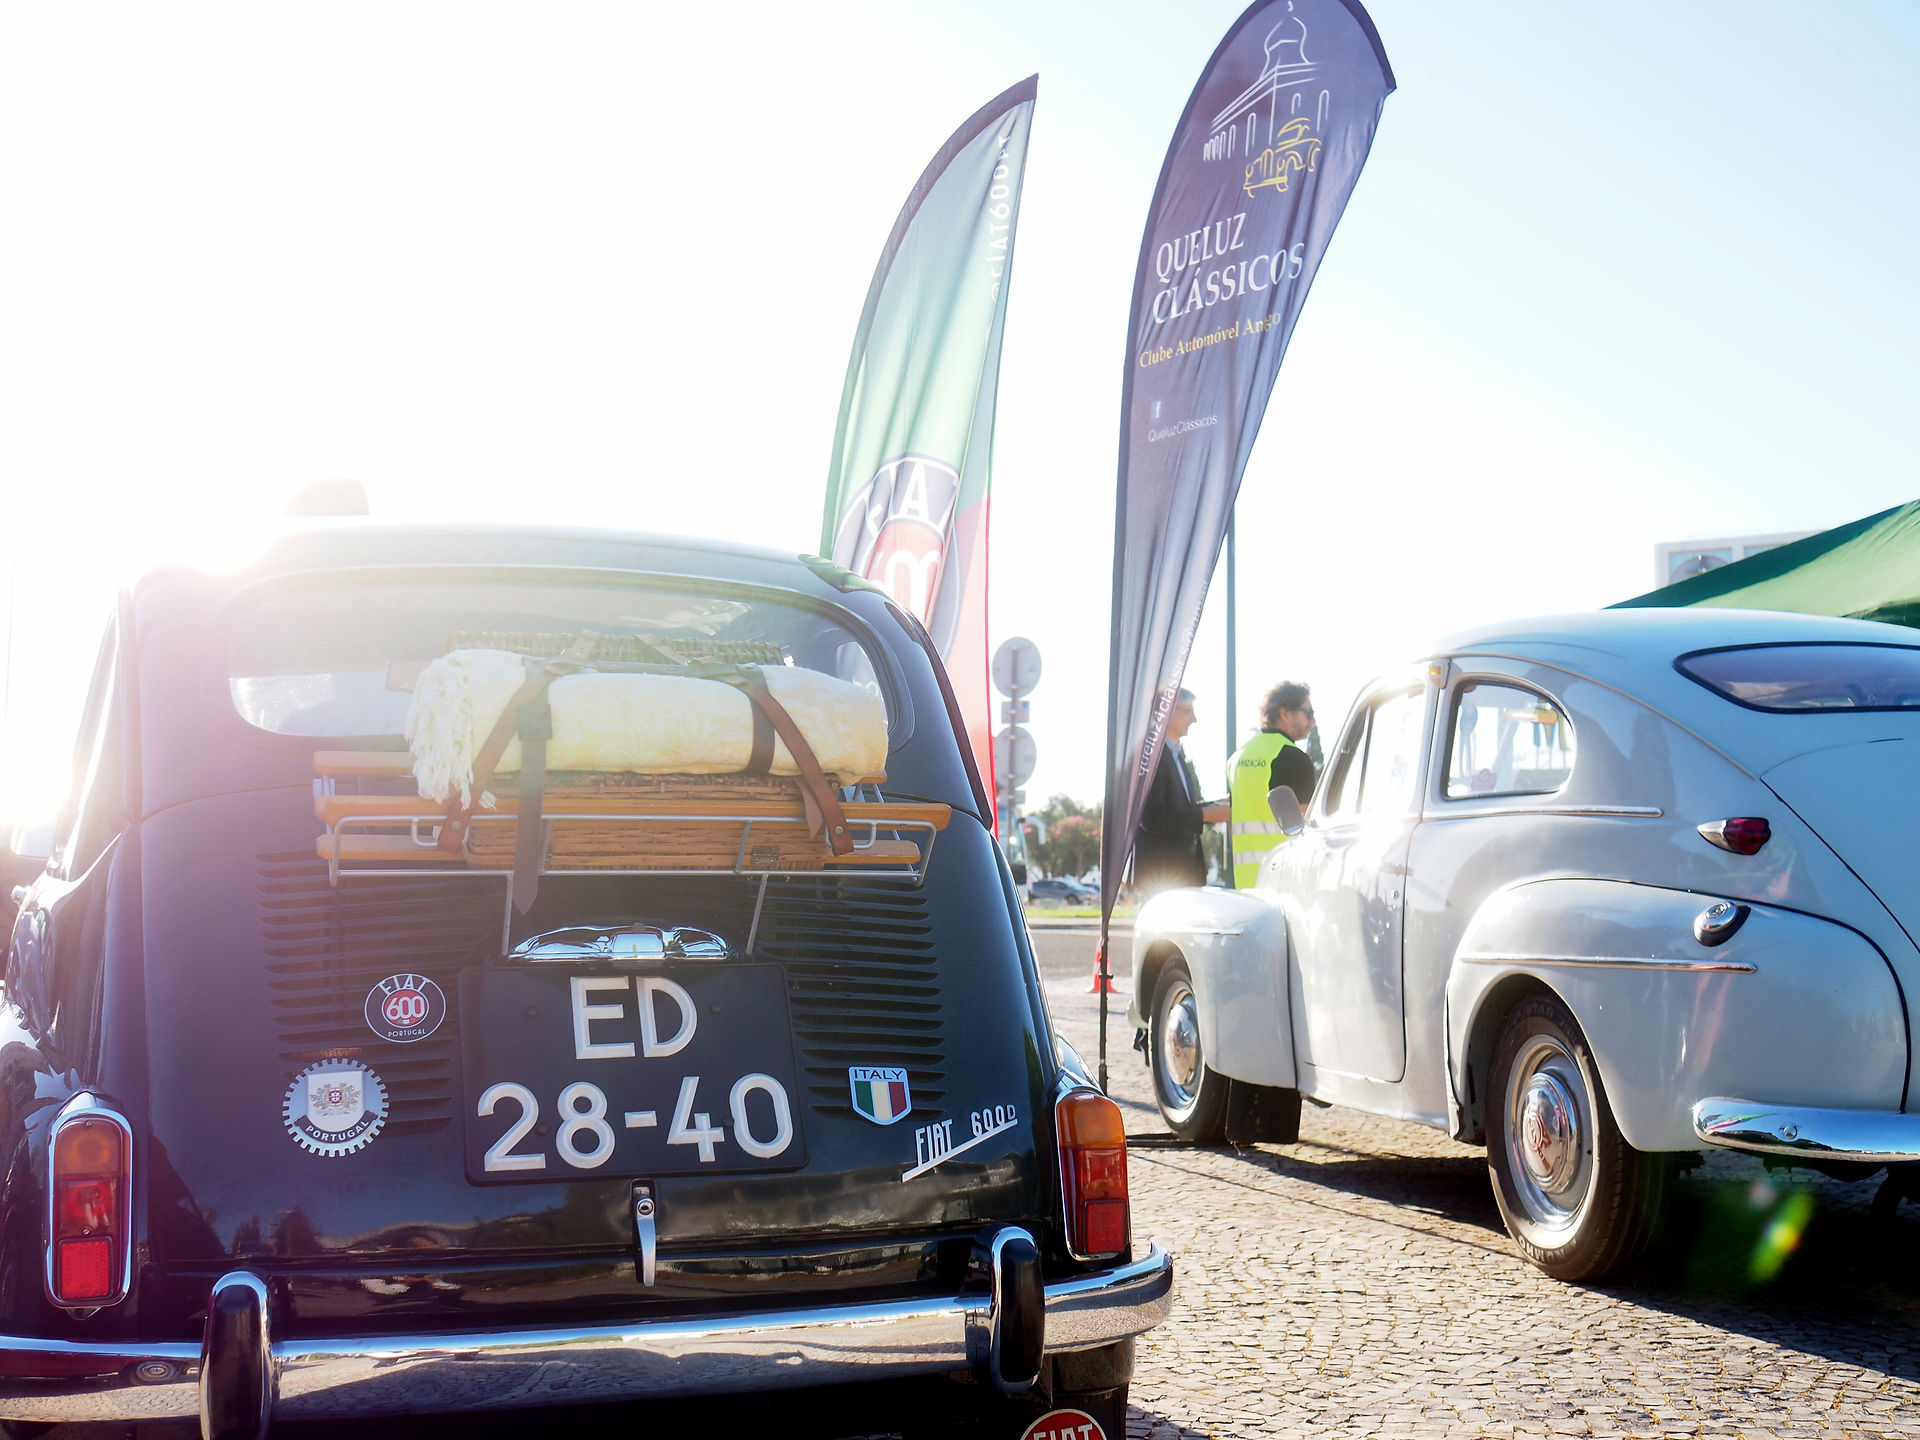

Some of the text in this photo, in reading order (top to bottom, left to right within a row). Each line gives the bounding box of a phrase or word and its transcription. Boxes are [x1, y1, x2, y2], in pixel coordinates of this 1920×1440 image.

[1156, 212, 1246, 284] QUELUZ
[1152, 243, 1305, 325] CLÁSSICOS
[1139, 346, 1173, 368] Clube
[1175, 321, 1239, 356] Automóvel
[379, 975, 430, 995] FIAT
[387, 996, 425, 1020] 600
[388, 1028, 426, 1037] PORTUGAL
[570, 976, 697, 1060] ED
[854, 1069, 903, 1080] ITALY
[305, 1121, 369, 1141] PORTUGAL
[477, 1072, 794, 1172] 28-40
[915, 1104, 1016, 1168] FIAT 600D
